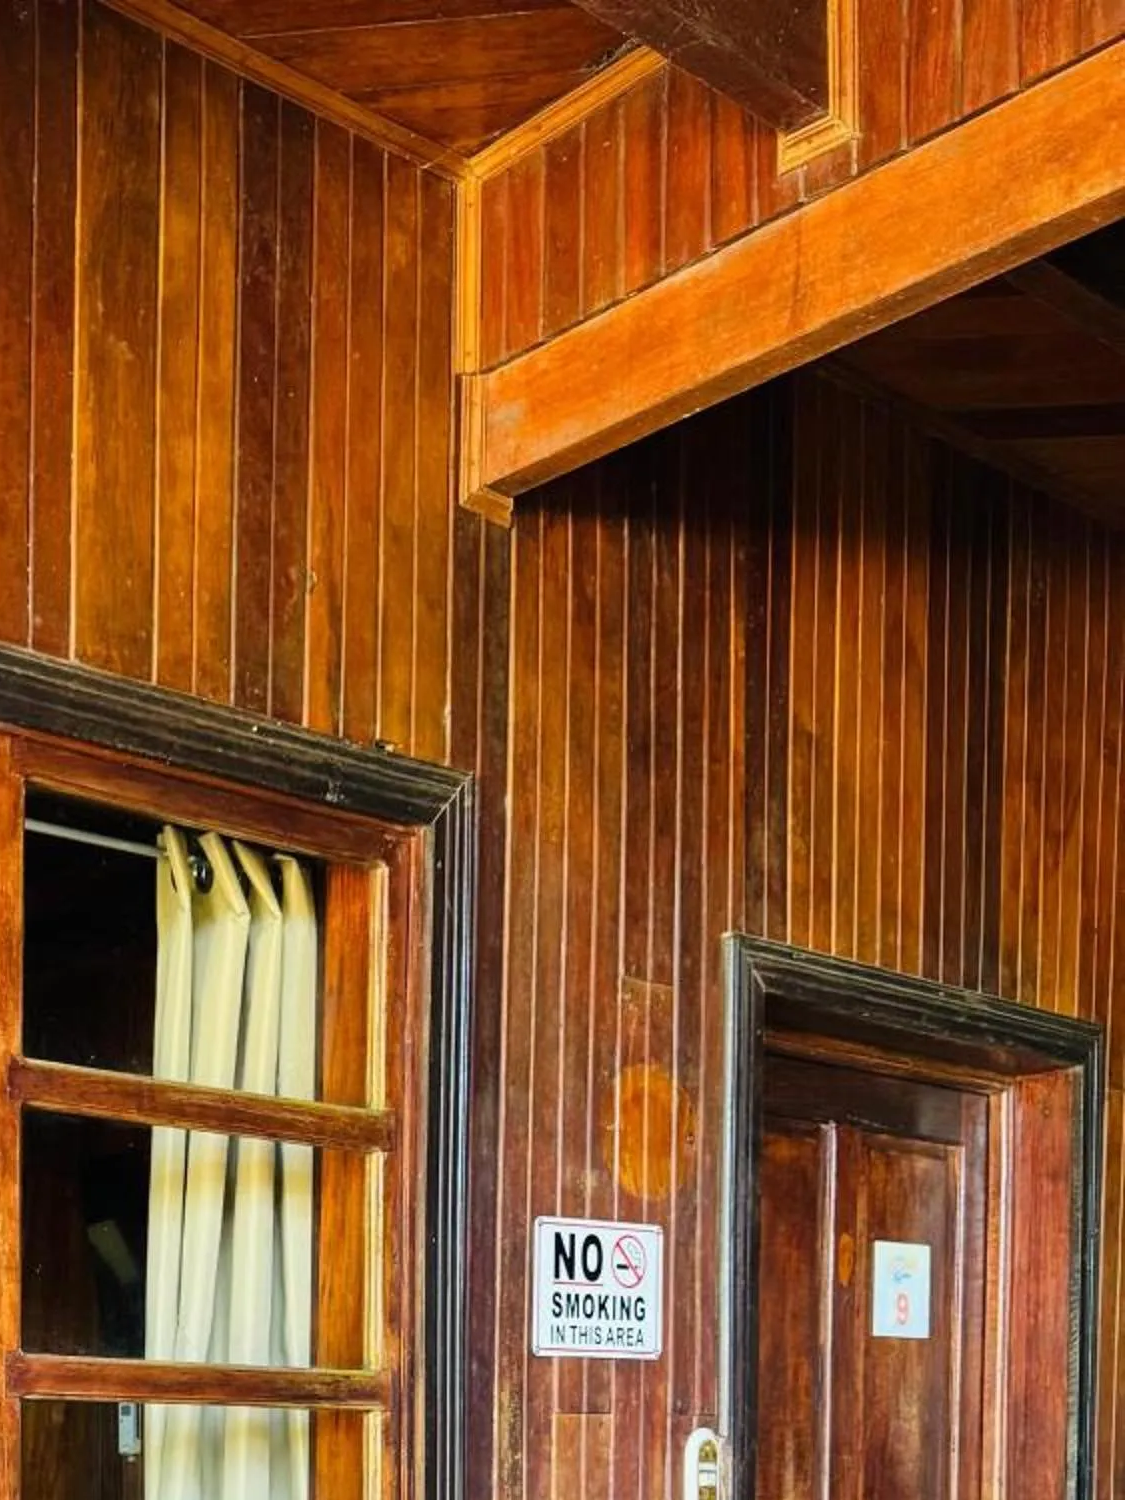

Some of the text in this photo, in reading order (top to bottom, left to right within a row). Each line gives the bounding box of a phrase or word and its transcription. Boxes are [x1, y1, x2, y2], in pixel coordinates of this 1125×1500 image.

[554, 1232, 603, 1282] NO
[552, 1292, 646, 1321] SMOKING
[550, 1325, 644, 1347] IN THIS AREA
